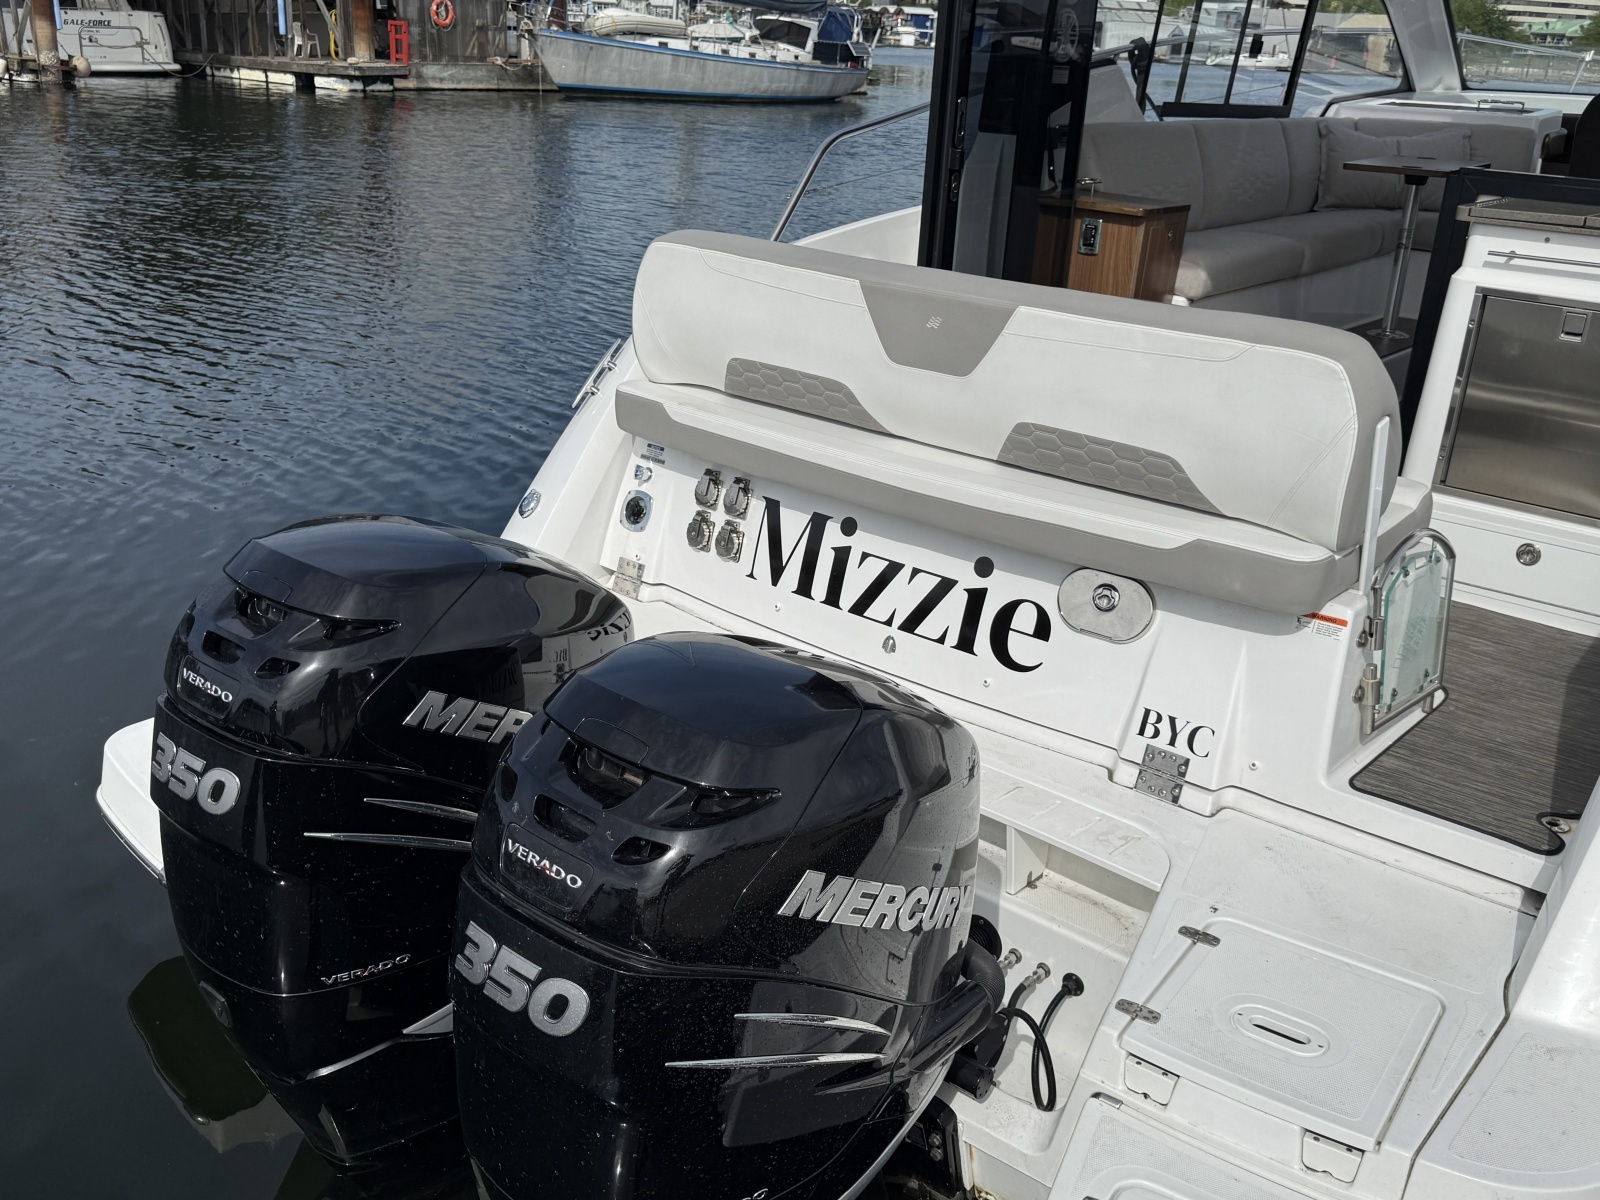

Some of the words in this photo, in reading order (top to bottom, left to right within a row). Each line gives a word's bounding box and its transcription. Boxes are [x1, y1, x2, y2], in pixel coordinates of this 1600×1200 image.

[745, 495, 1052, 673] Mizzie
[182, 667, 234, 703] VERADO
[1136, 706, 1216, 758] BYC
[150, 731, 242, 815] 350
[506, 838, 583, 889] VERADO
[777, 869, 971, 932] MERCURY
[321, 953, 411, 986] VERADO
[454, 920, 591, 1037] 350
